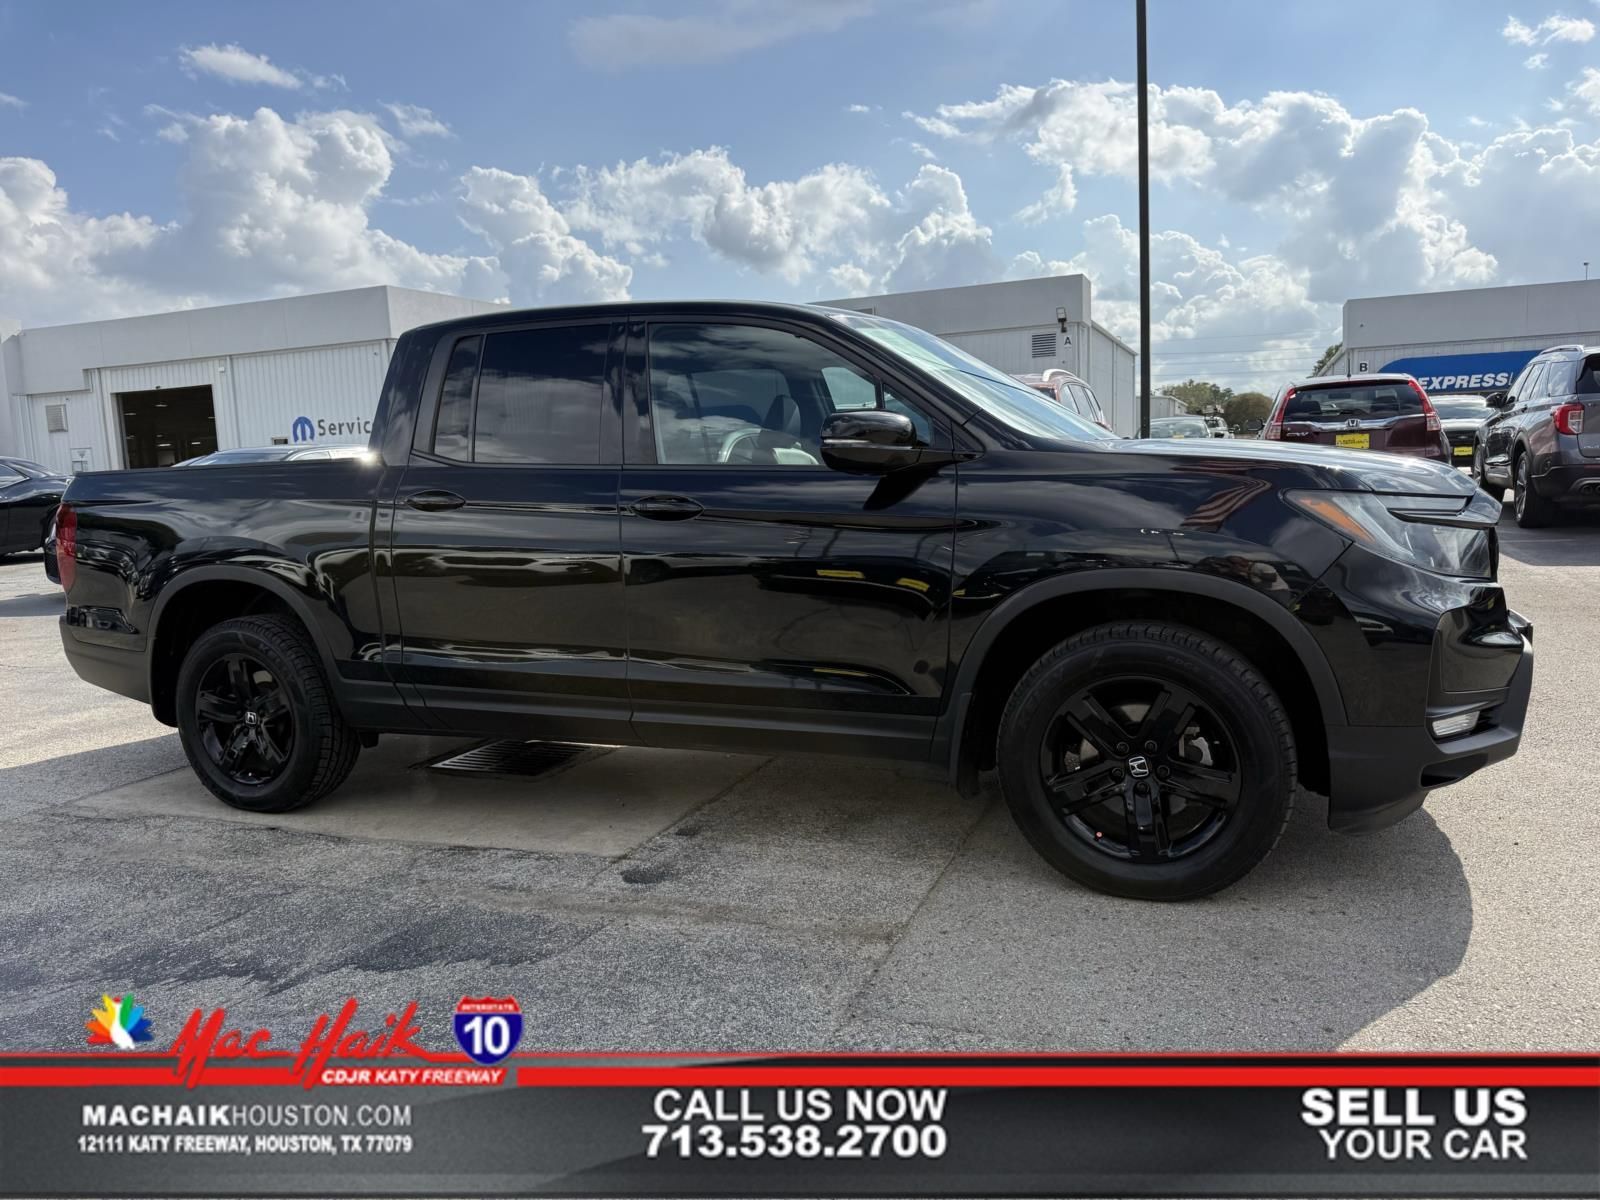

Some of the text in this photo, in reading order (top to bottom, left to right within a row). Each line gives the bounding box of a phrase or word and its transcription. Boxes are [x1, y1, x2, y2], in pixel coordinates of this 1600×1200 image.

[1064, 336, 1072, 346] A
[1359, 362, 1368, 373] B
[1418, 372, 1508, 390] EXPRESS
[317, 416, 373, 436] Servic
